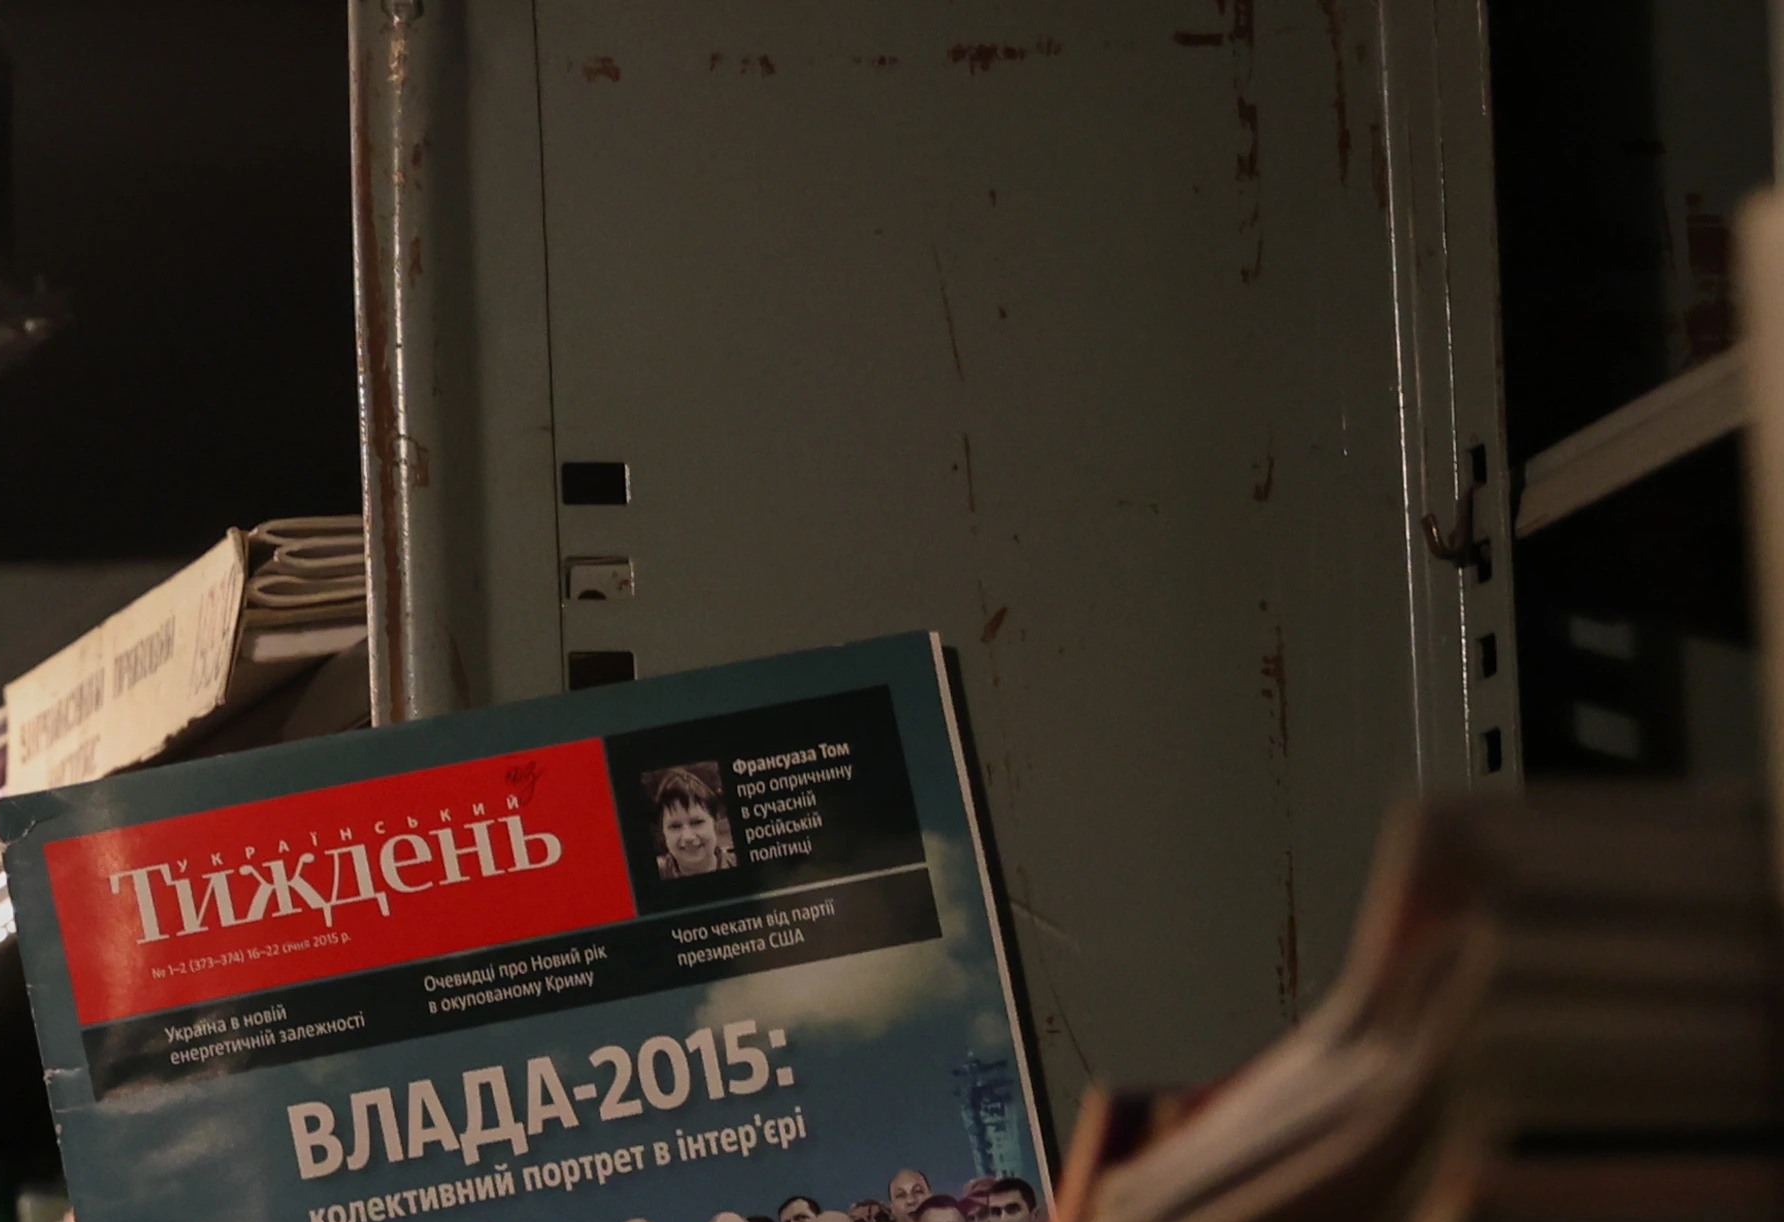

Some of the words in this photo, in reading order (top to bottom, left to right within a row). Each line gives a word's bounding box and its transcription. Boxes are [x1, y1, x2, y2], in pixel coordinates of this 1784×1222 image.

[732, 749, 817, 777] Франсуаза
[818, 742, 851, 760] Том
[737, 781, 765, 799] про
[769, 765, 853, 791] опричнину
[741, 806, 750, 820] в
[753, 790, 817, 818] сучасній
[177, 794, 519, 873] УКРАЇНСЬКИЙ
[745, 812, 823, 844] російській
[749, 836, 813, 863] політиці
[313, 934, 339, 948] 2015
[671, 926, 708, 944] Чого
[711, 916, 763, 937] чекати
[766, 908, 790, 928] від
[791, 898, 835, 923] партії
[424, 963, 496, 992] Очевидці
[499, 962, 528, 980] про
[531, 948, 581, 972] Новий
[584, 944, 608, 965] рік
[677, 938, 766, 968] президента
[769, 928, 805, 948] США
[428, 1000, 438, 1014] в
[441, 980, 542, 1012] окупованому
[545, 970, 595, 993] Криму
[165, 1017, 227, 1044] Україна
[230, 1016, 240, 1030] в
[243, 1004, 288, 1028] новій
[170, 1028, 277, 1065] енергетичній
[279, 1010, 366, 1044] залежності
[287, 1018, 795, 1180] ВЛАДА-2015:
[522, 1144, 645, 1193] портрет
[654, 1140, 671, 1165] в
